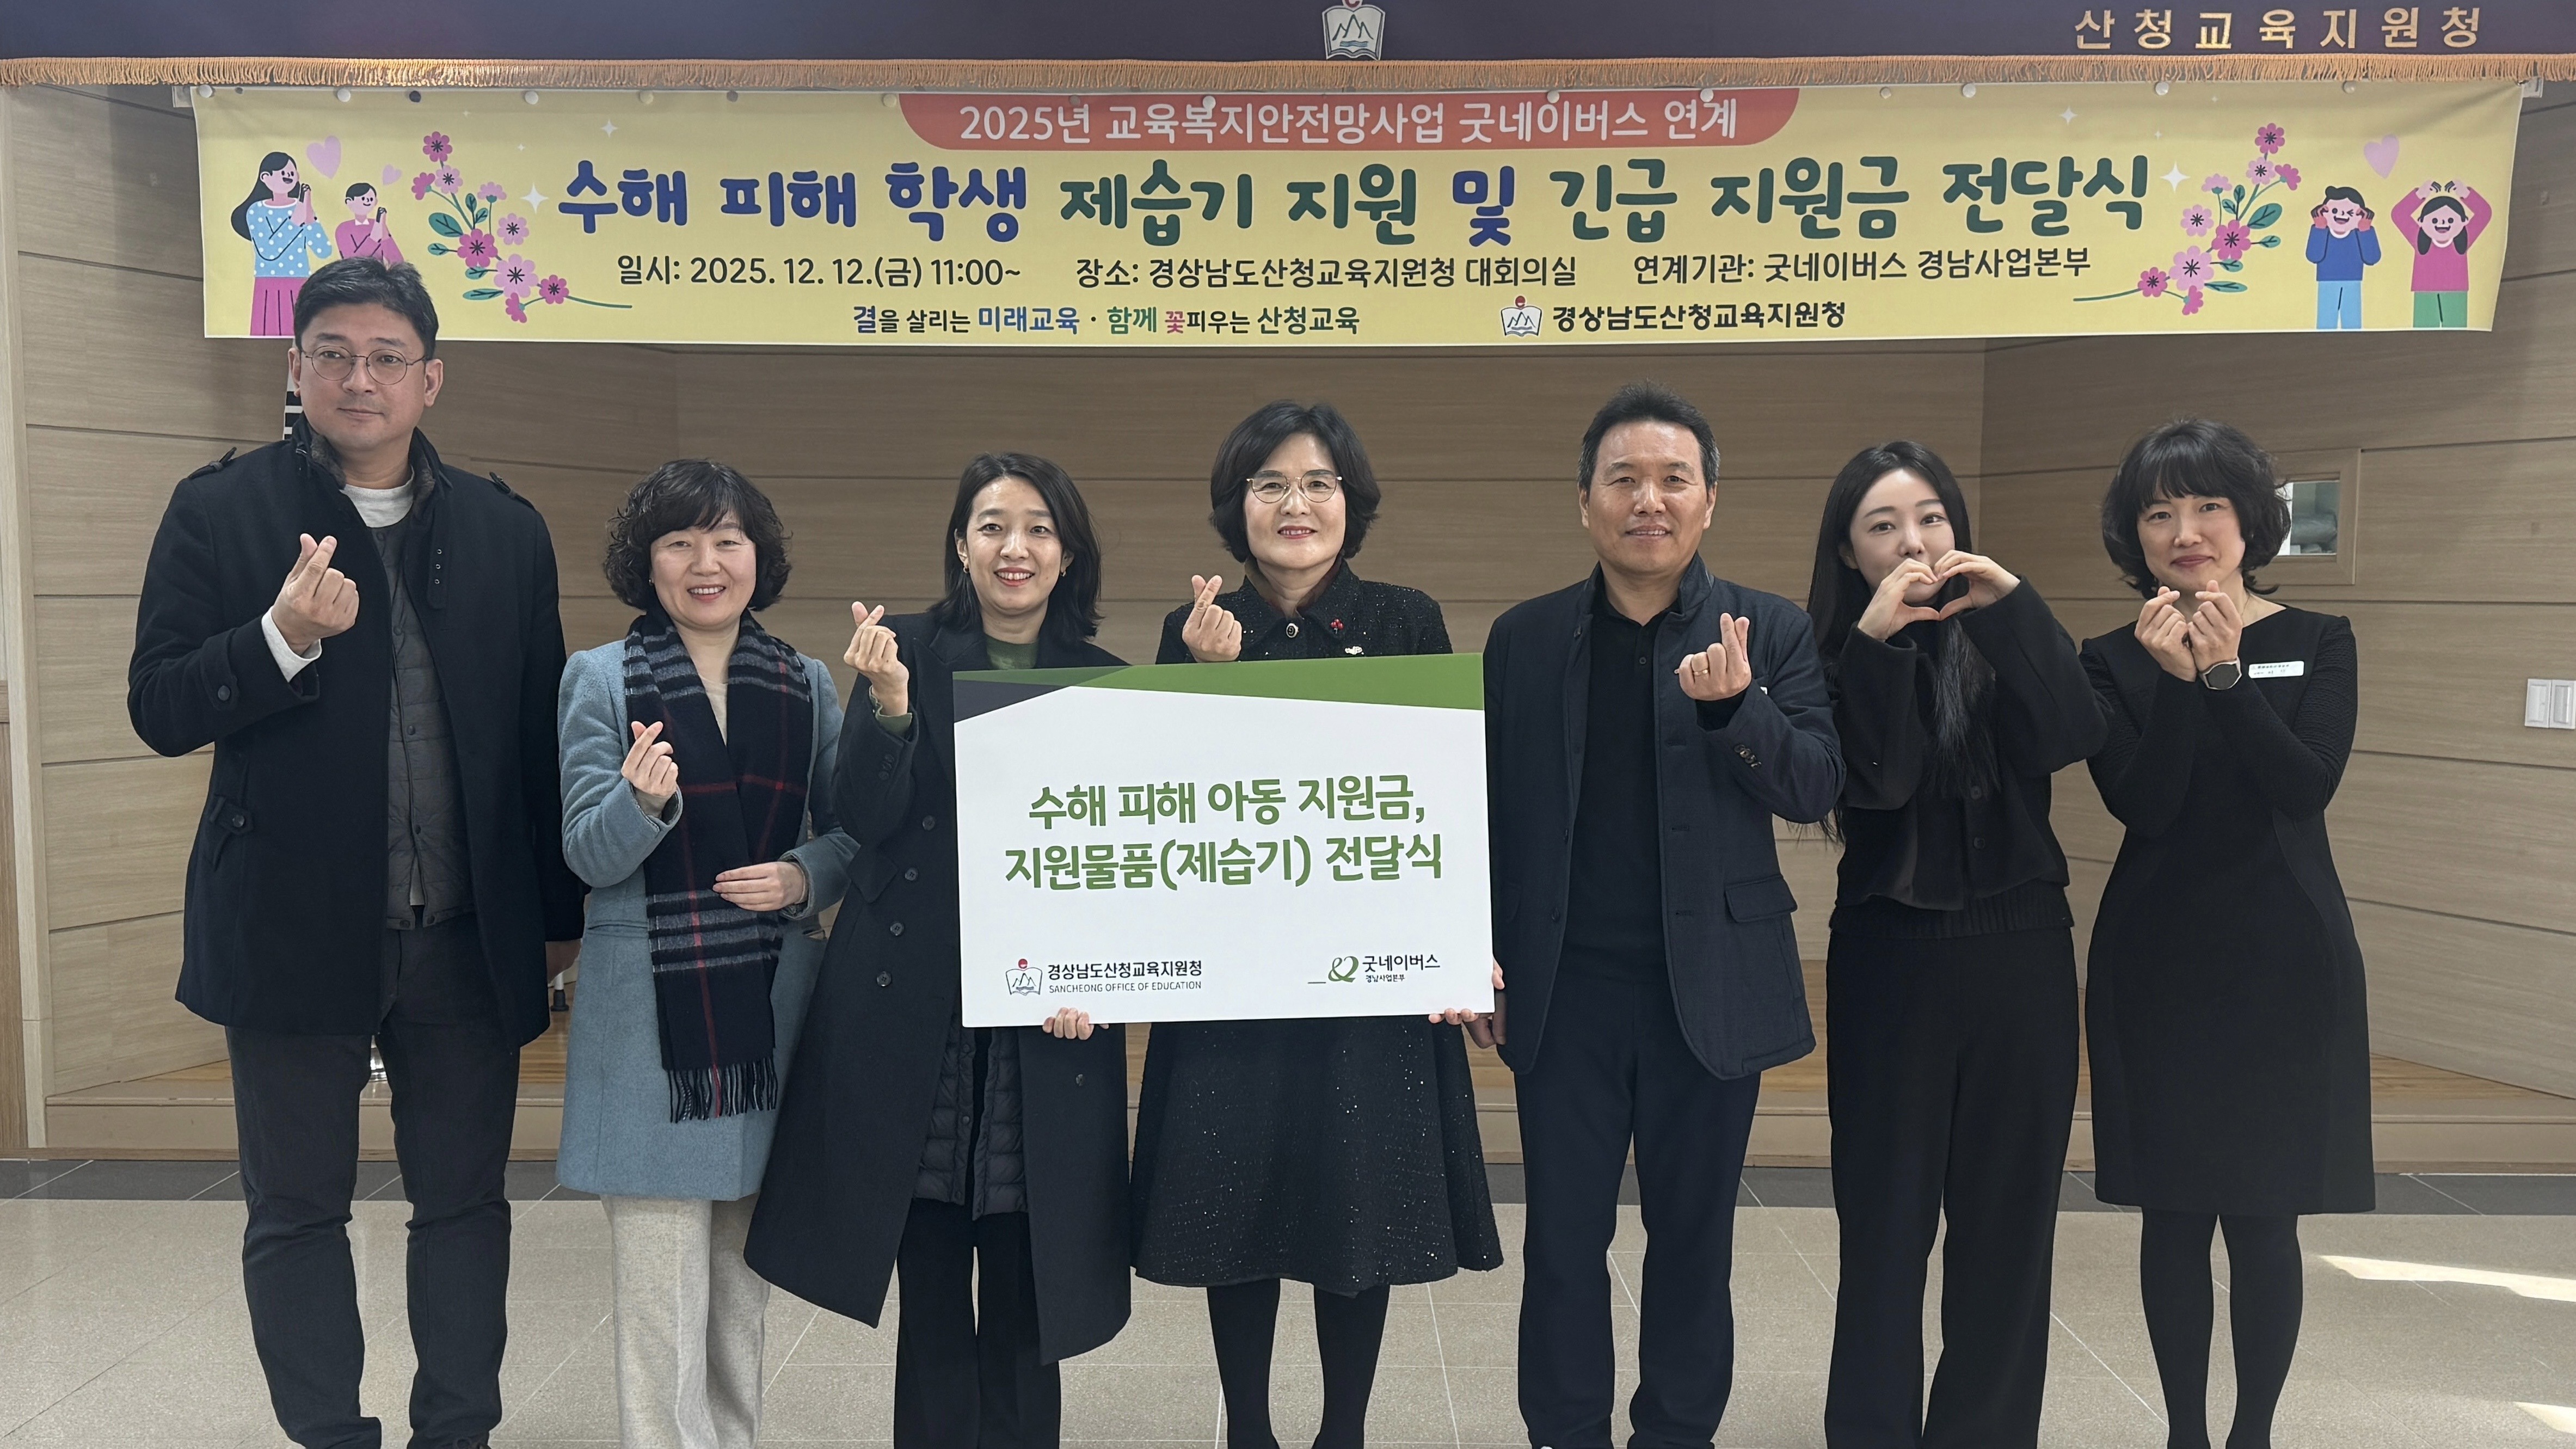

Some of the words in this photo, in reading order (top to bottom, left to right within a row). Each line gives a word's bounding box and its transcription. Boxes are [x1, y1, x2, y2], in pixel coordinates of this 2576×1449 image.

[960, 104, 1090, 143] 2025년
[1105, 102, 1443, 144] 교육복지안전망사업
[1459, 100, 1649, 144] 굿네이버스
[1664, 98, 1736, 139] 연계
[558, 160, 687, 234] 수해
[720, 170, 856, 228] 피해
[884, 162, 1026, 243] 학생
[1060, 159, 1253, 247] 제습기
[1286, 163, 1416, 245] 지원
[1452, 165, 1515, 247] 및
[1549, 158, 1677, 243] 긴급
[1710, 156, 1909, 240] 지원금
[1942, 155, 2148, 237] 전달식
[617, 255, 680, 285] 일시:
[690, 257, 775, 285] 2025.
[783, 258, 824, 285] 12.
[931, 259, 1020, 285] 11:00~
[1076, 259, 1139, 288] 장소:
[1149, 257, 1454, 288] 경상남도산청교육지원청
[1466, 256, 1576, 287] 대회의실
[1634, 254, 1754, 285] 연계기관:
[1763, 251, 1907, 283] 굿네이버스
[1917, 247, 2091, 280] 경남사업본부
[853, 305, 900, 334] 결을
[906, 309, 971, 334] 살리는
[979, 306, 1080, 335] 미래교육
[1106, 306, 1157, 335] 함께
[1164, 310, 1251, 334] 꽃피우는
[1257, 305, 1360, 335] 산청교육
[1553, 301, 1845, 333] 경상남도산청교육지원청
[1029, 784, 1106, 830] 수해
[1118, 781, 1196, 825] 피해
[1208, 778, 1287, 825] 아동
[1298, 775, 1424, 824] 지원금,
[1005, 835, 1311, 891] 지원물품(제습기)
[1325, 833, 1441, 881] 전달식
[1048, 960, 1202, 980] 경상남도산청교육지원청
[1362, 954, 1441, 973] 굿네이버스
[1049, 983, 1103, 993] SANCHEONG
[1105, 983, 1136, 992] OFFICE
[1138, 982, 1149, 991] OF
[1152, 981, 1201, 991] EDUCATION
